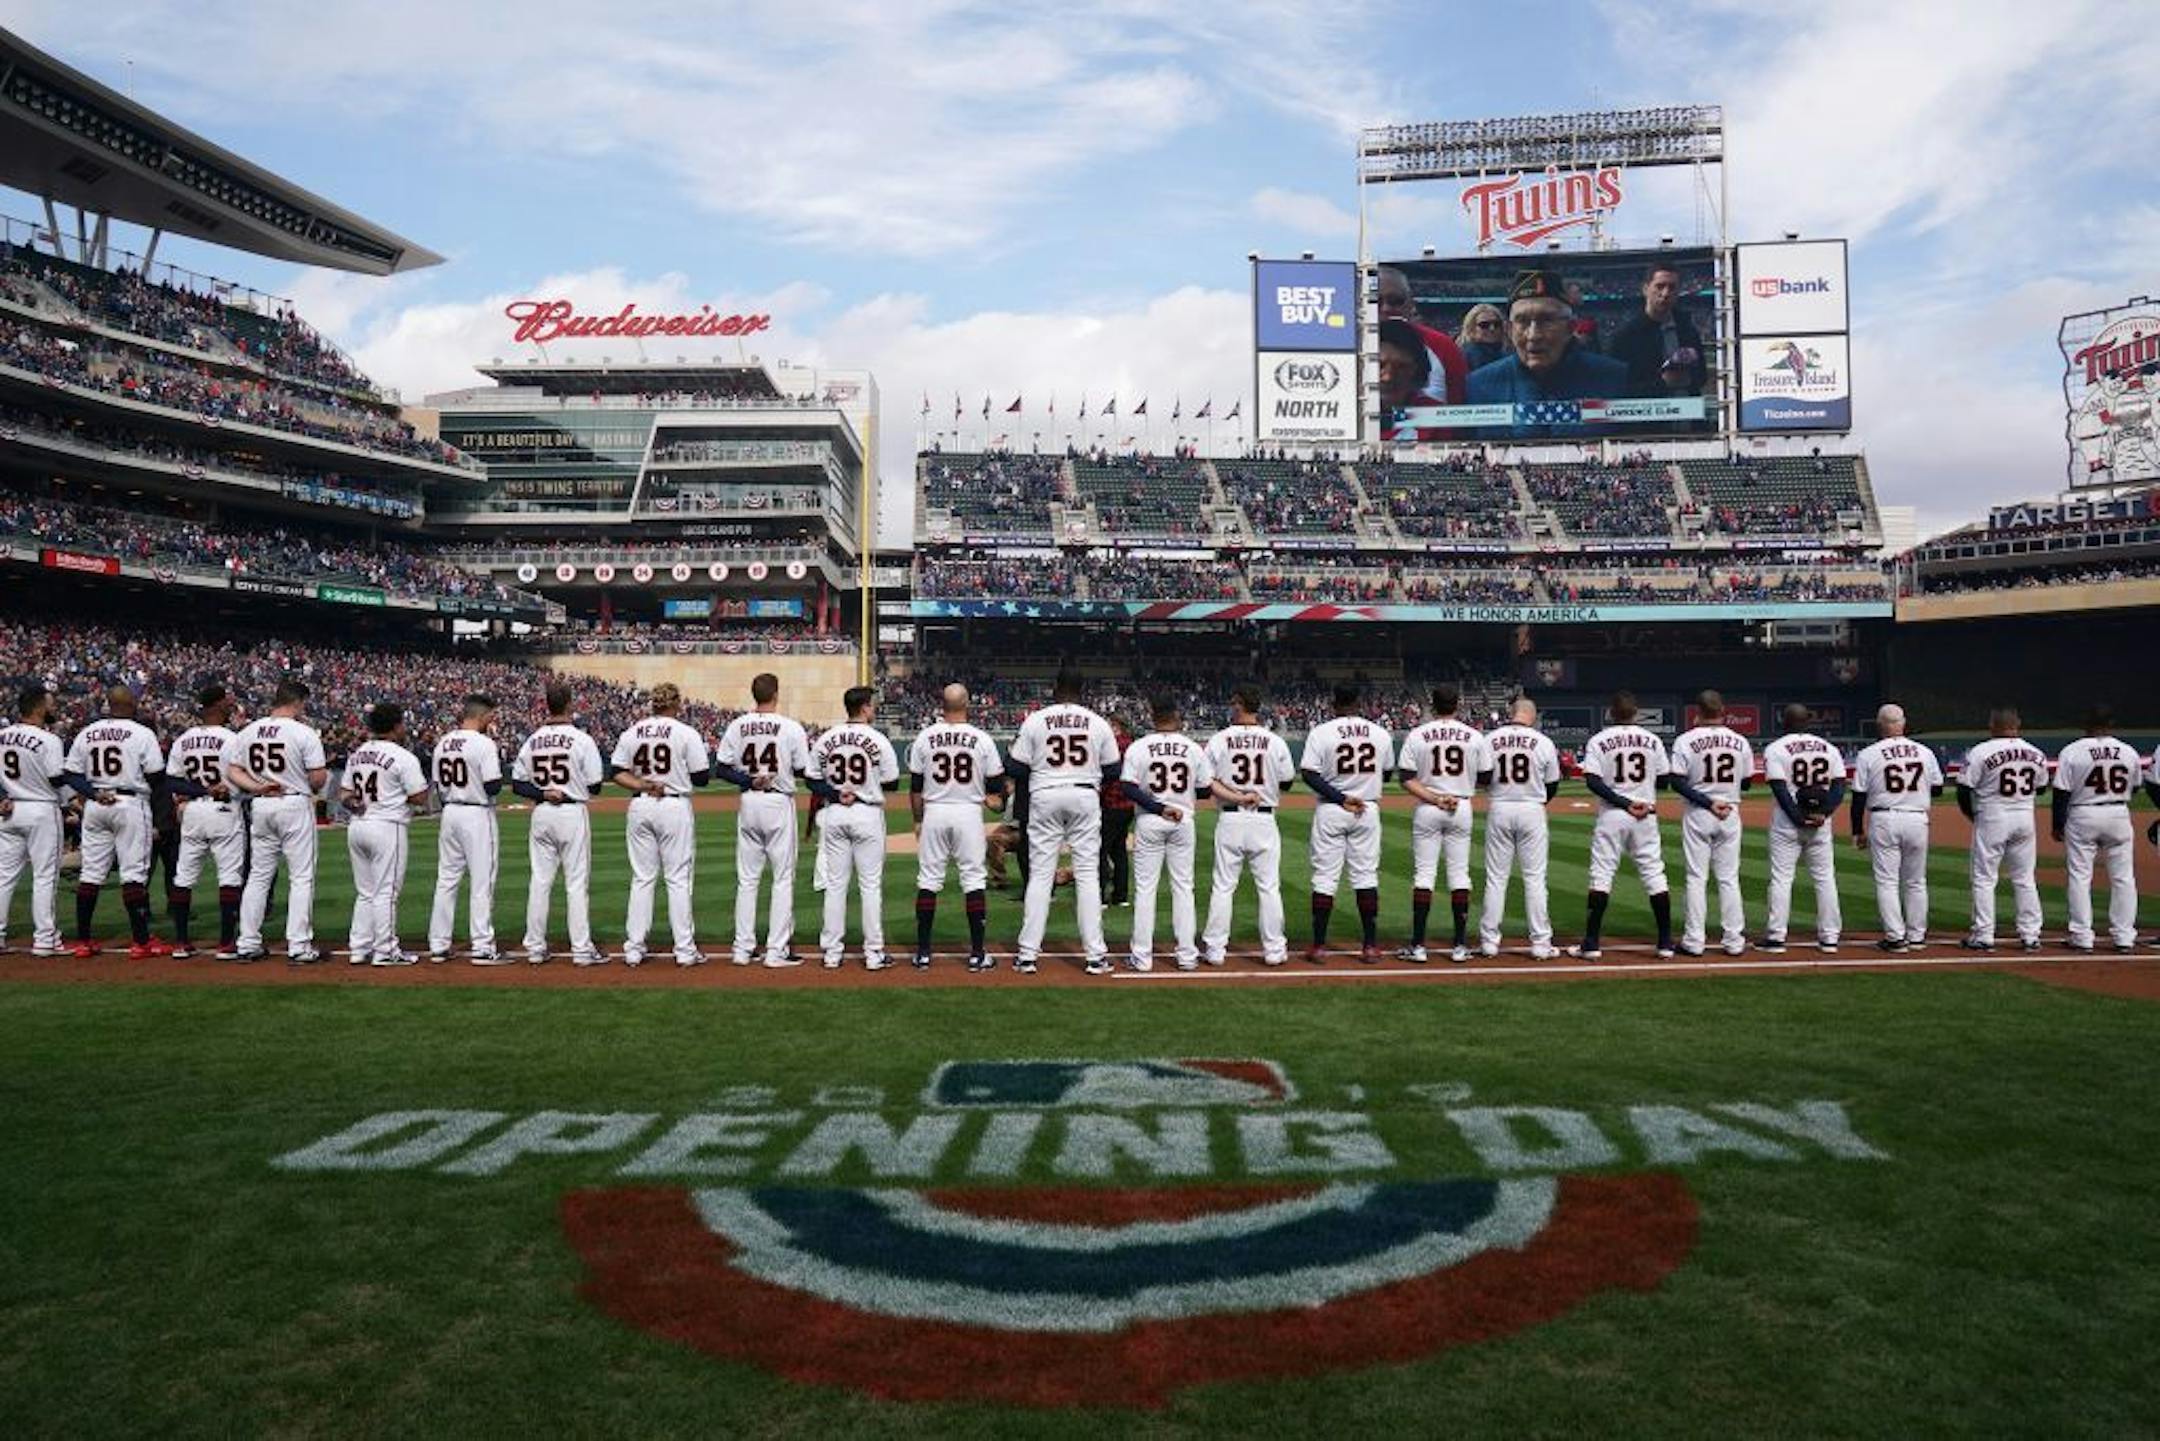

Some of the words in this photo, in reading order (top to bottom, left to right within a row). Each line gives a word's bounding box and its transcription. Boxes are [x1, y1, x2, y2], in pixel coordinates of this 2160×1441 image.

[1460, 165, 1622, 246] Twins
[1277, 286, 1336, 305] BEST
[506, 300, 770, 343] Budweiser
[1281, 305, 1331, 324] BUY
[1287, 381, 1328, 390] SPORTS
[1288, 364, 1326, 381] FOX
[1753, 372, 1795, 387] Treasure
[1805, 368, 1836, 385] Island
[1275, 400, 1339, 418] NORTH
[487, 434, 495, 446] A
[497, 433, 553, 447] BEAUTIFUL
[556, 432, 574, 446] DAY
[537, 480, 575, 495] TWINS
[1990, 496, 2143, 528] TARGET
[1441, 608, 1464, 619] WE
[1469, 607, 1522, 620] HONOR
[1526, 607, 1598, 621] AMERICA
[85, 728, 133, 744] SCHOOP
[256, 725, 282, 739] MAY
[739, 722, 781, 737] GIBSON
[1045, 713, 1089, 731] PINEDA
[1422, 727, 1471, 744] HARPER
[531, 735, 575, 750] ROGERS
[928, 732, 978, 750] PARKER
[1046, 735, 1088, 767] 35
[1226, 736, 1270, 750] AUSTIN
[1491, 735, 1537, 751] GARVER
[1600, 732, 1657, 753] ADRIANZA
[1689, 733, 1744, 753] ODORIZZI
[1881, 745, 1919, 760] EVERS
[4, 750, 21, 779] 9
[90, 746, 122, 777] 16
[184, 755, 221, 785] 25
[249, 742, 286, 772] 65
[439, 757, 468, 787] 60
[532, 753, 570, 786] 55
[632, 743, 672, 774] 49
[741, 742, 778, 773] 44
[829, 753, 867, 785] 39
[931, 752, 973, 784] 38
[1232, 753, 1264, 785] 31
[1337, 743, 1375, 774] 22
[1430, 745, 1465, 776] 19
[1497, 753, 1529, 783] 18
[1614, 752, 1646, 783] 13
[1702, 753, 1734, 783] 12
[351, 770, 378, 801] 64
[1149, 761, 1189, 793] 33
[1791, 757, 1830, 788] 82
[1884, 762, 1924, 793] 67
[1999, 767, 2036, 797] 63
[2084, 764, 2129, 795] 46
[268, 1107, 1396, 1176] OPENING
[1444, 1100, 1894, 1171] DAY
